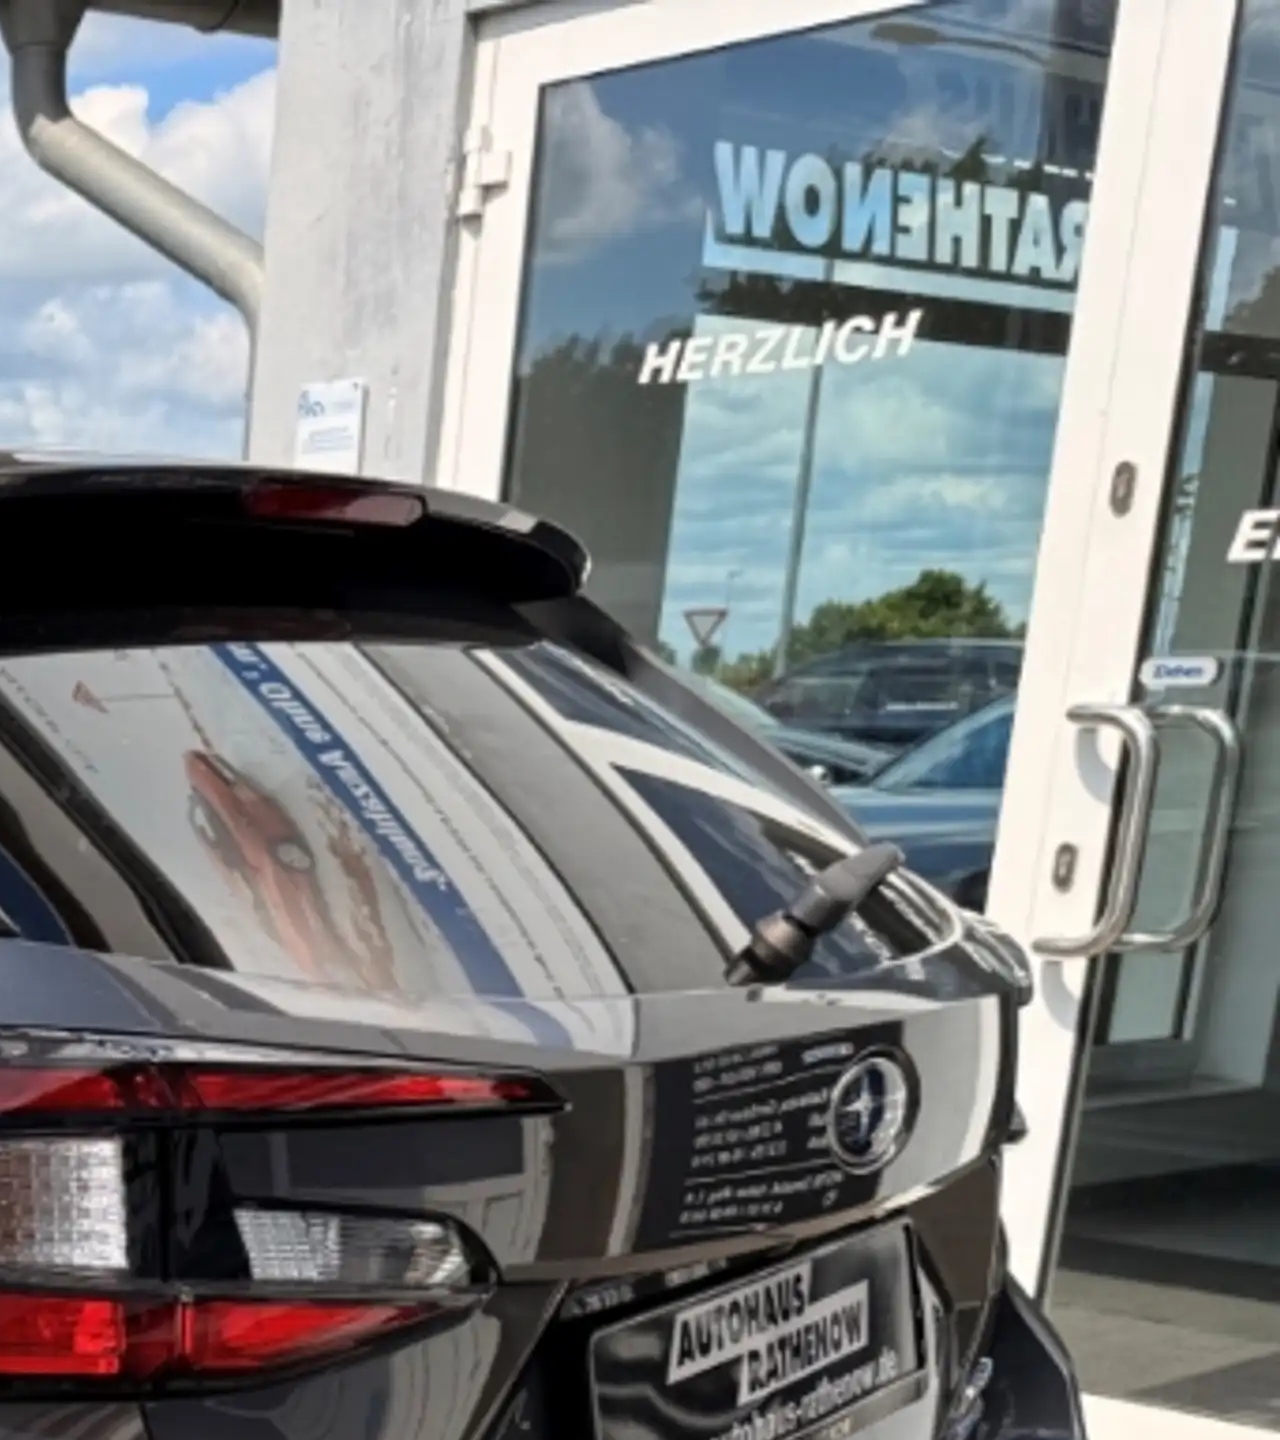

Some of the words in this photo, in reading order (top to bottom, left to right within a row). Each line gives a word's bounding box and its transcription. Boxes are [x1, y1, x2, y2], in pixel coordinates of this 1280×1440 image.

[638, 308, 924, 385] HERZLICH
[676, 1273, 807, 1371] AUTOHAUS
[748, 1300, 863, 1394] RATHENOW
